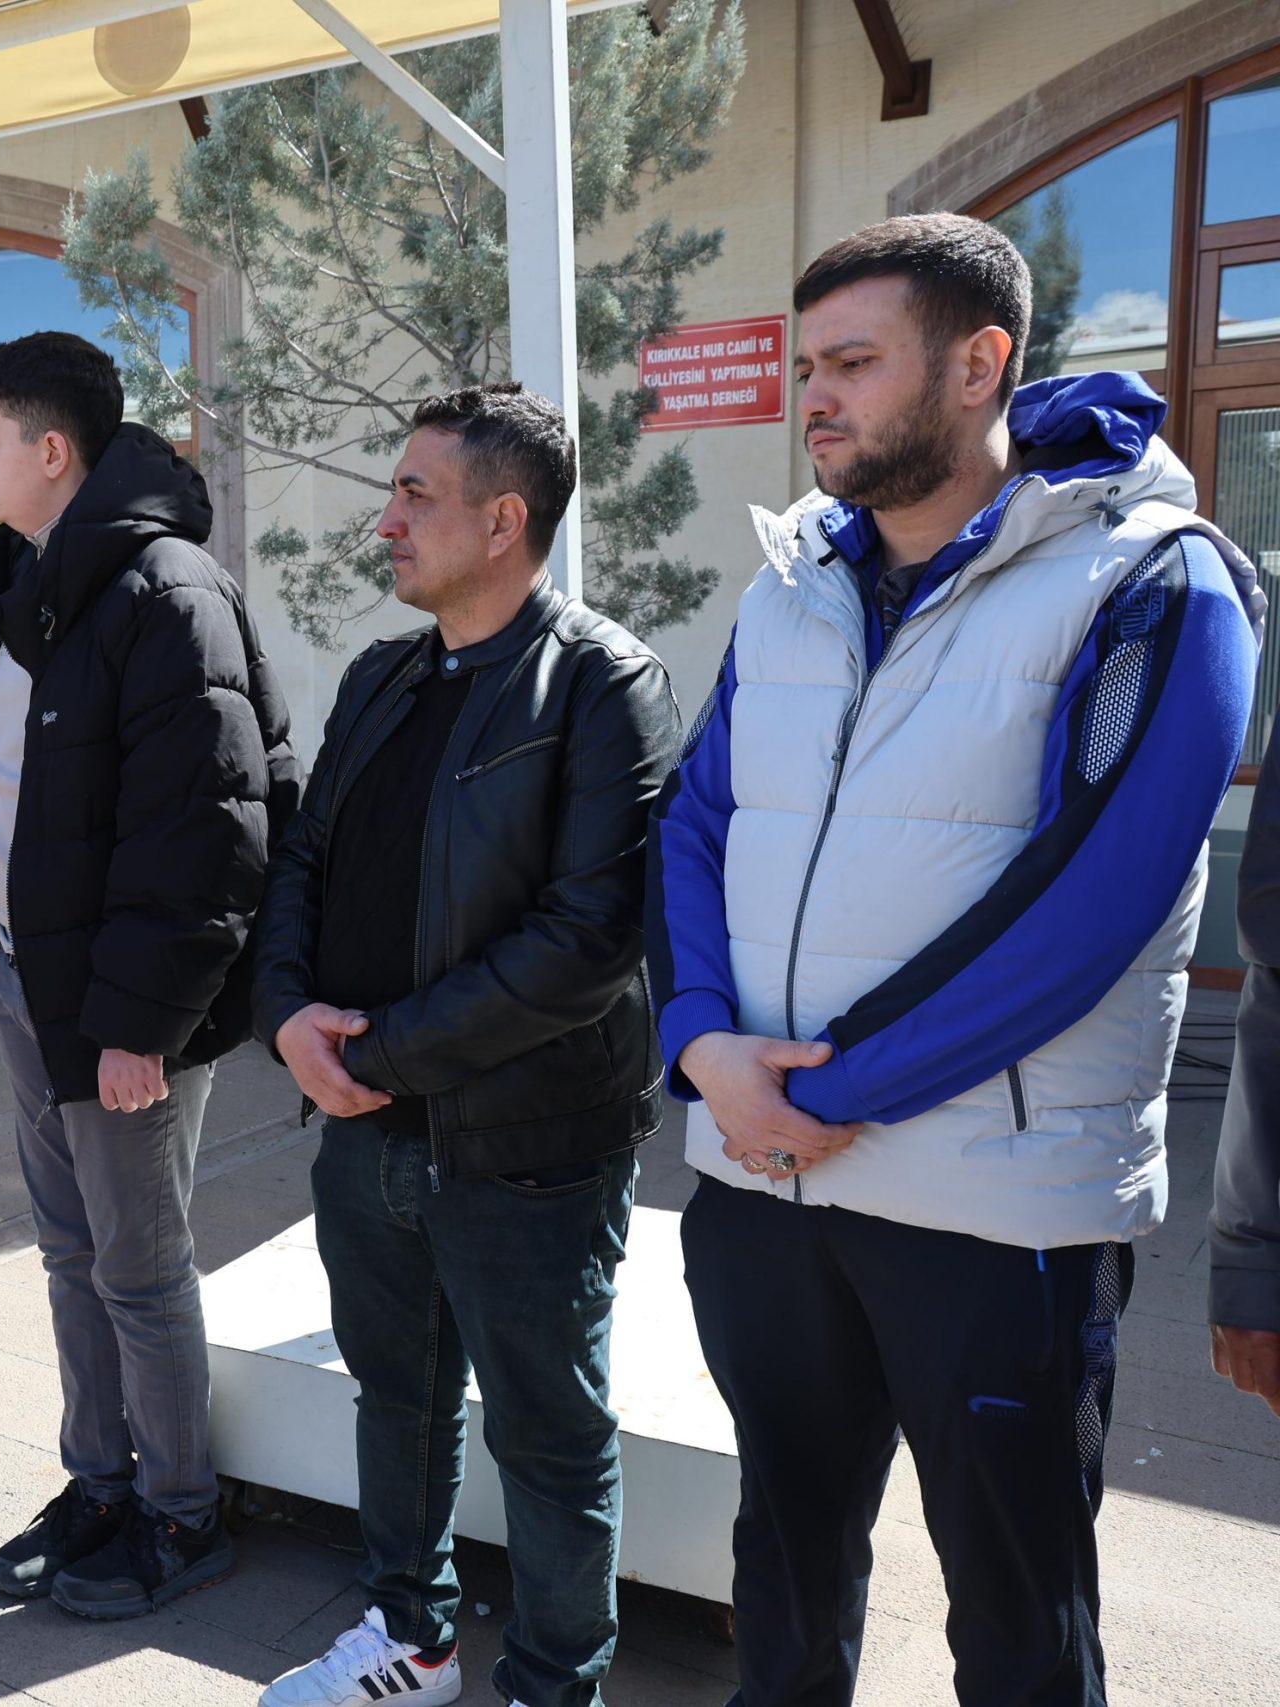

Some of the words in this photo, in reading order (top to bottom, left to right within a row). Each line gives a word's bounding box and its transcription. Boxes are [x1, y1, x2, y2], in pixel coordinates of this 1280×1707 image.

[647, 344, 701, 364] KIRIKKALE
[703, 343, 724, 358] NUR
[759, 337, 773, 352] VE
[644, 366, 705, 387] KÜLLİYESİNİ
[711, 363, 762, 381] YAPTIRMA
[764, 361, 779, 376] VE
[663, 393, 709, 412] YAŞATMA
[711, 385, 757, 406] DERNEĞİ
